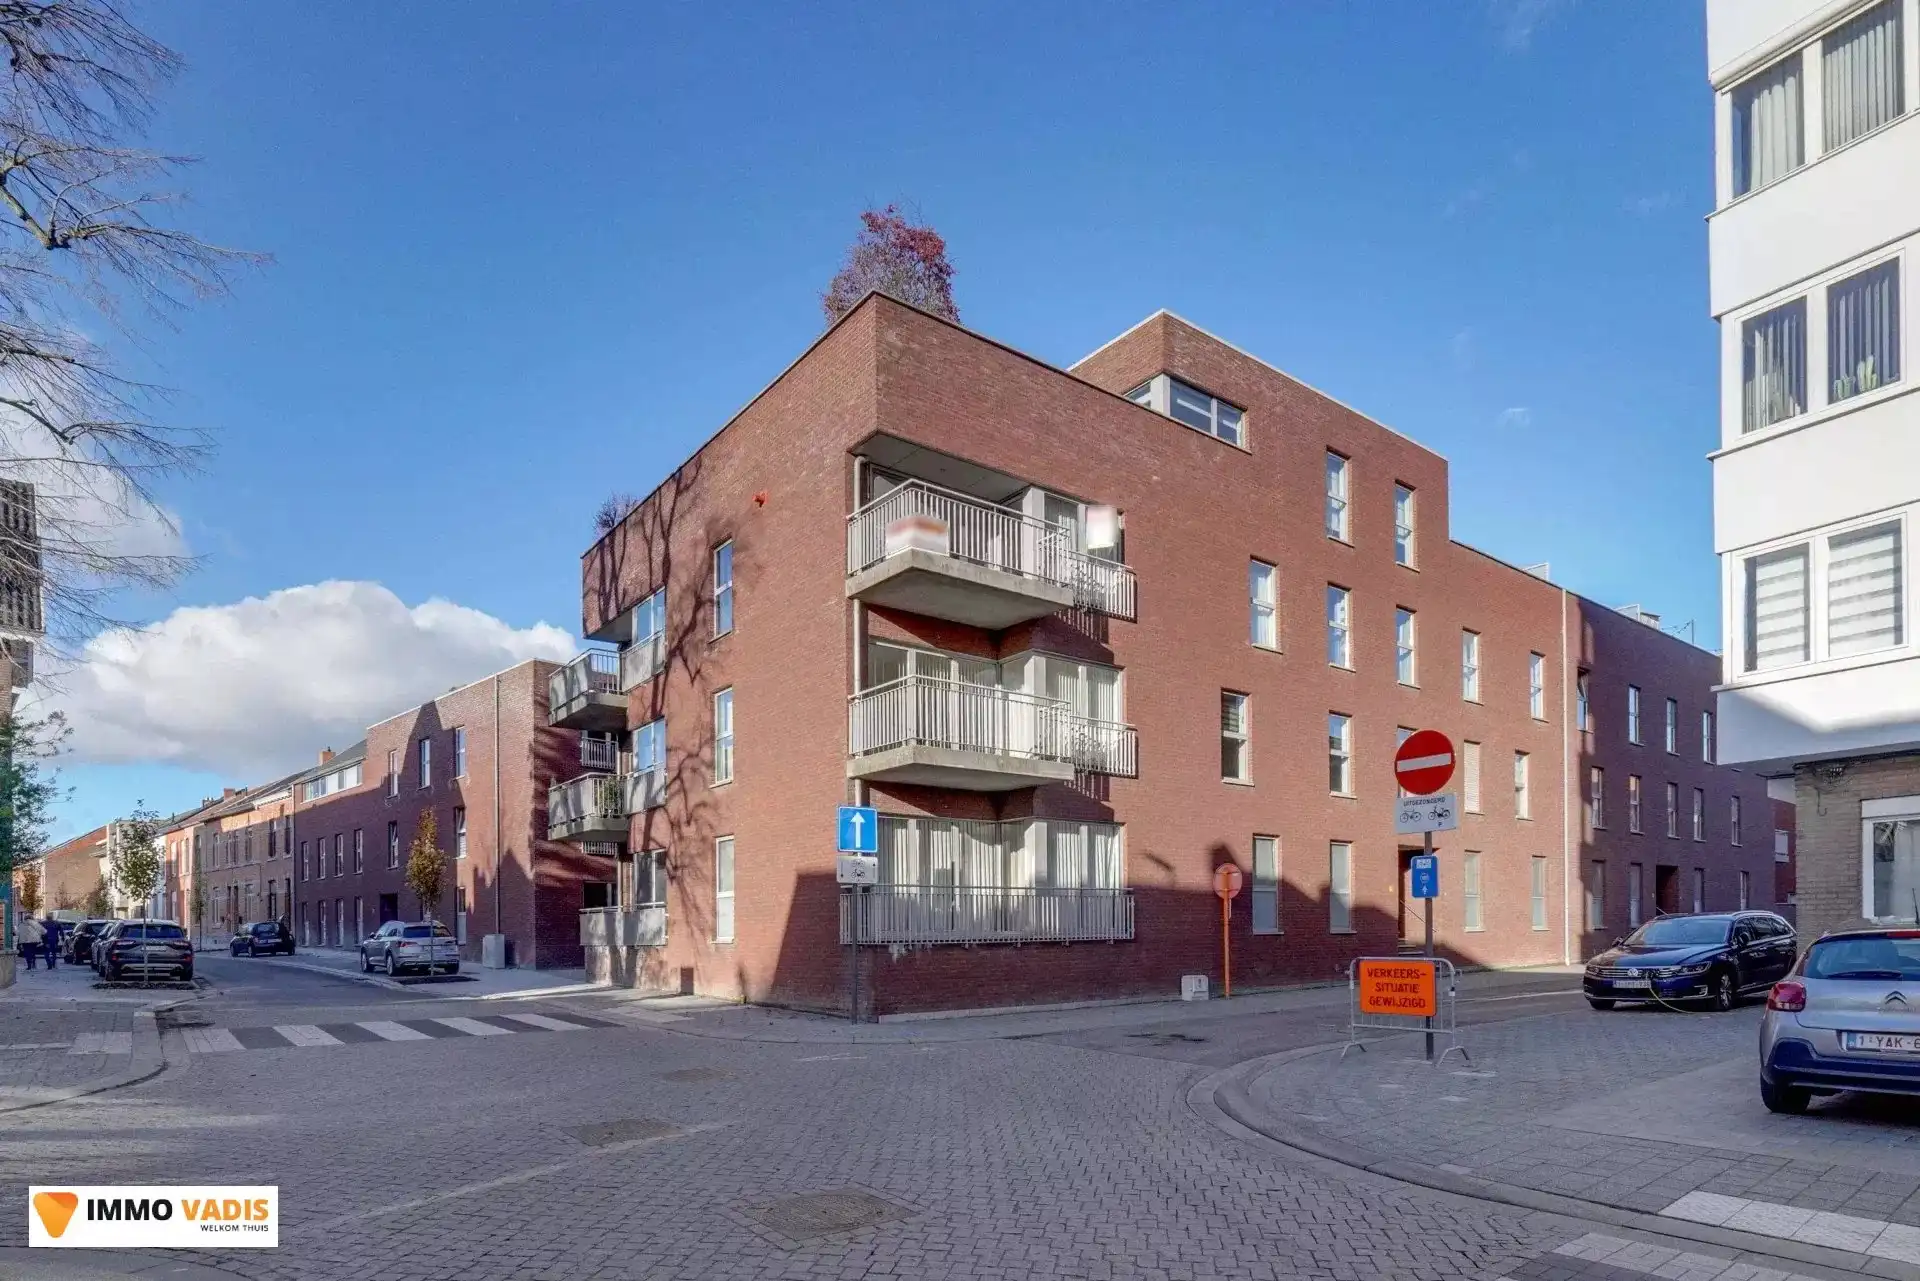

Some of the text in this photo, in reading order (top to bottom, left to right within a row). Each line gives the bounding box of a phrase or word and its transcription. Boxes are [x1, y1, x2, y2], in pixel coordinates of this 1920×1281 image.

[1367, 967, 1428, 979] VERKEERS-
[1374, 982, 1419, 993] SITUATIE
[1369, 996, 1426, 1008] GEWIJZIGD
